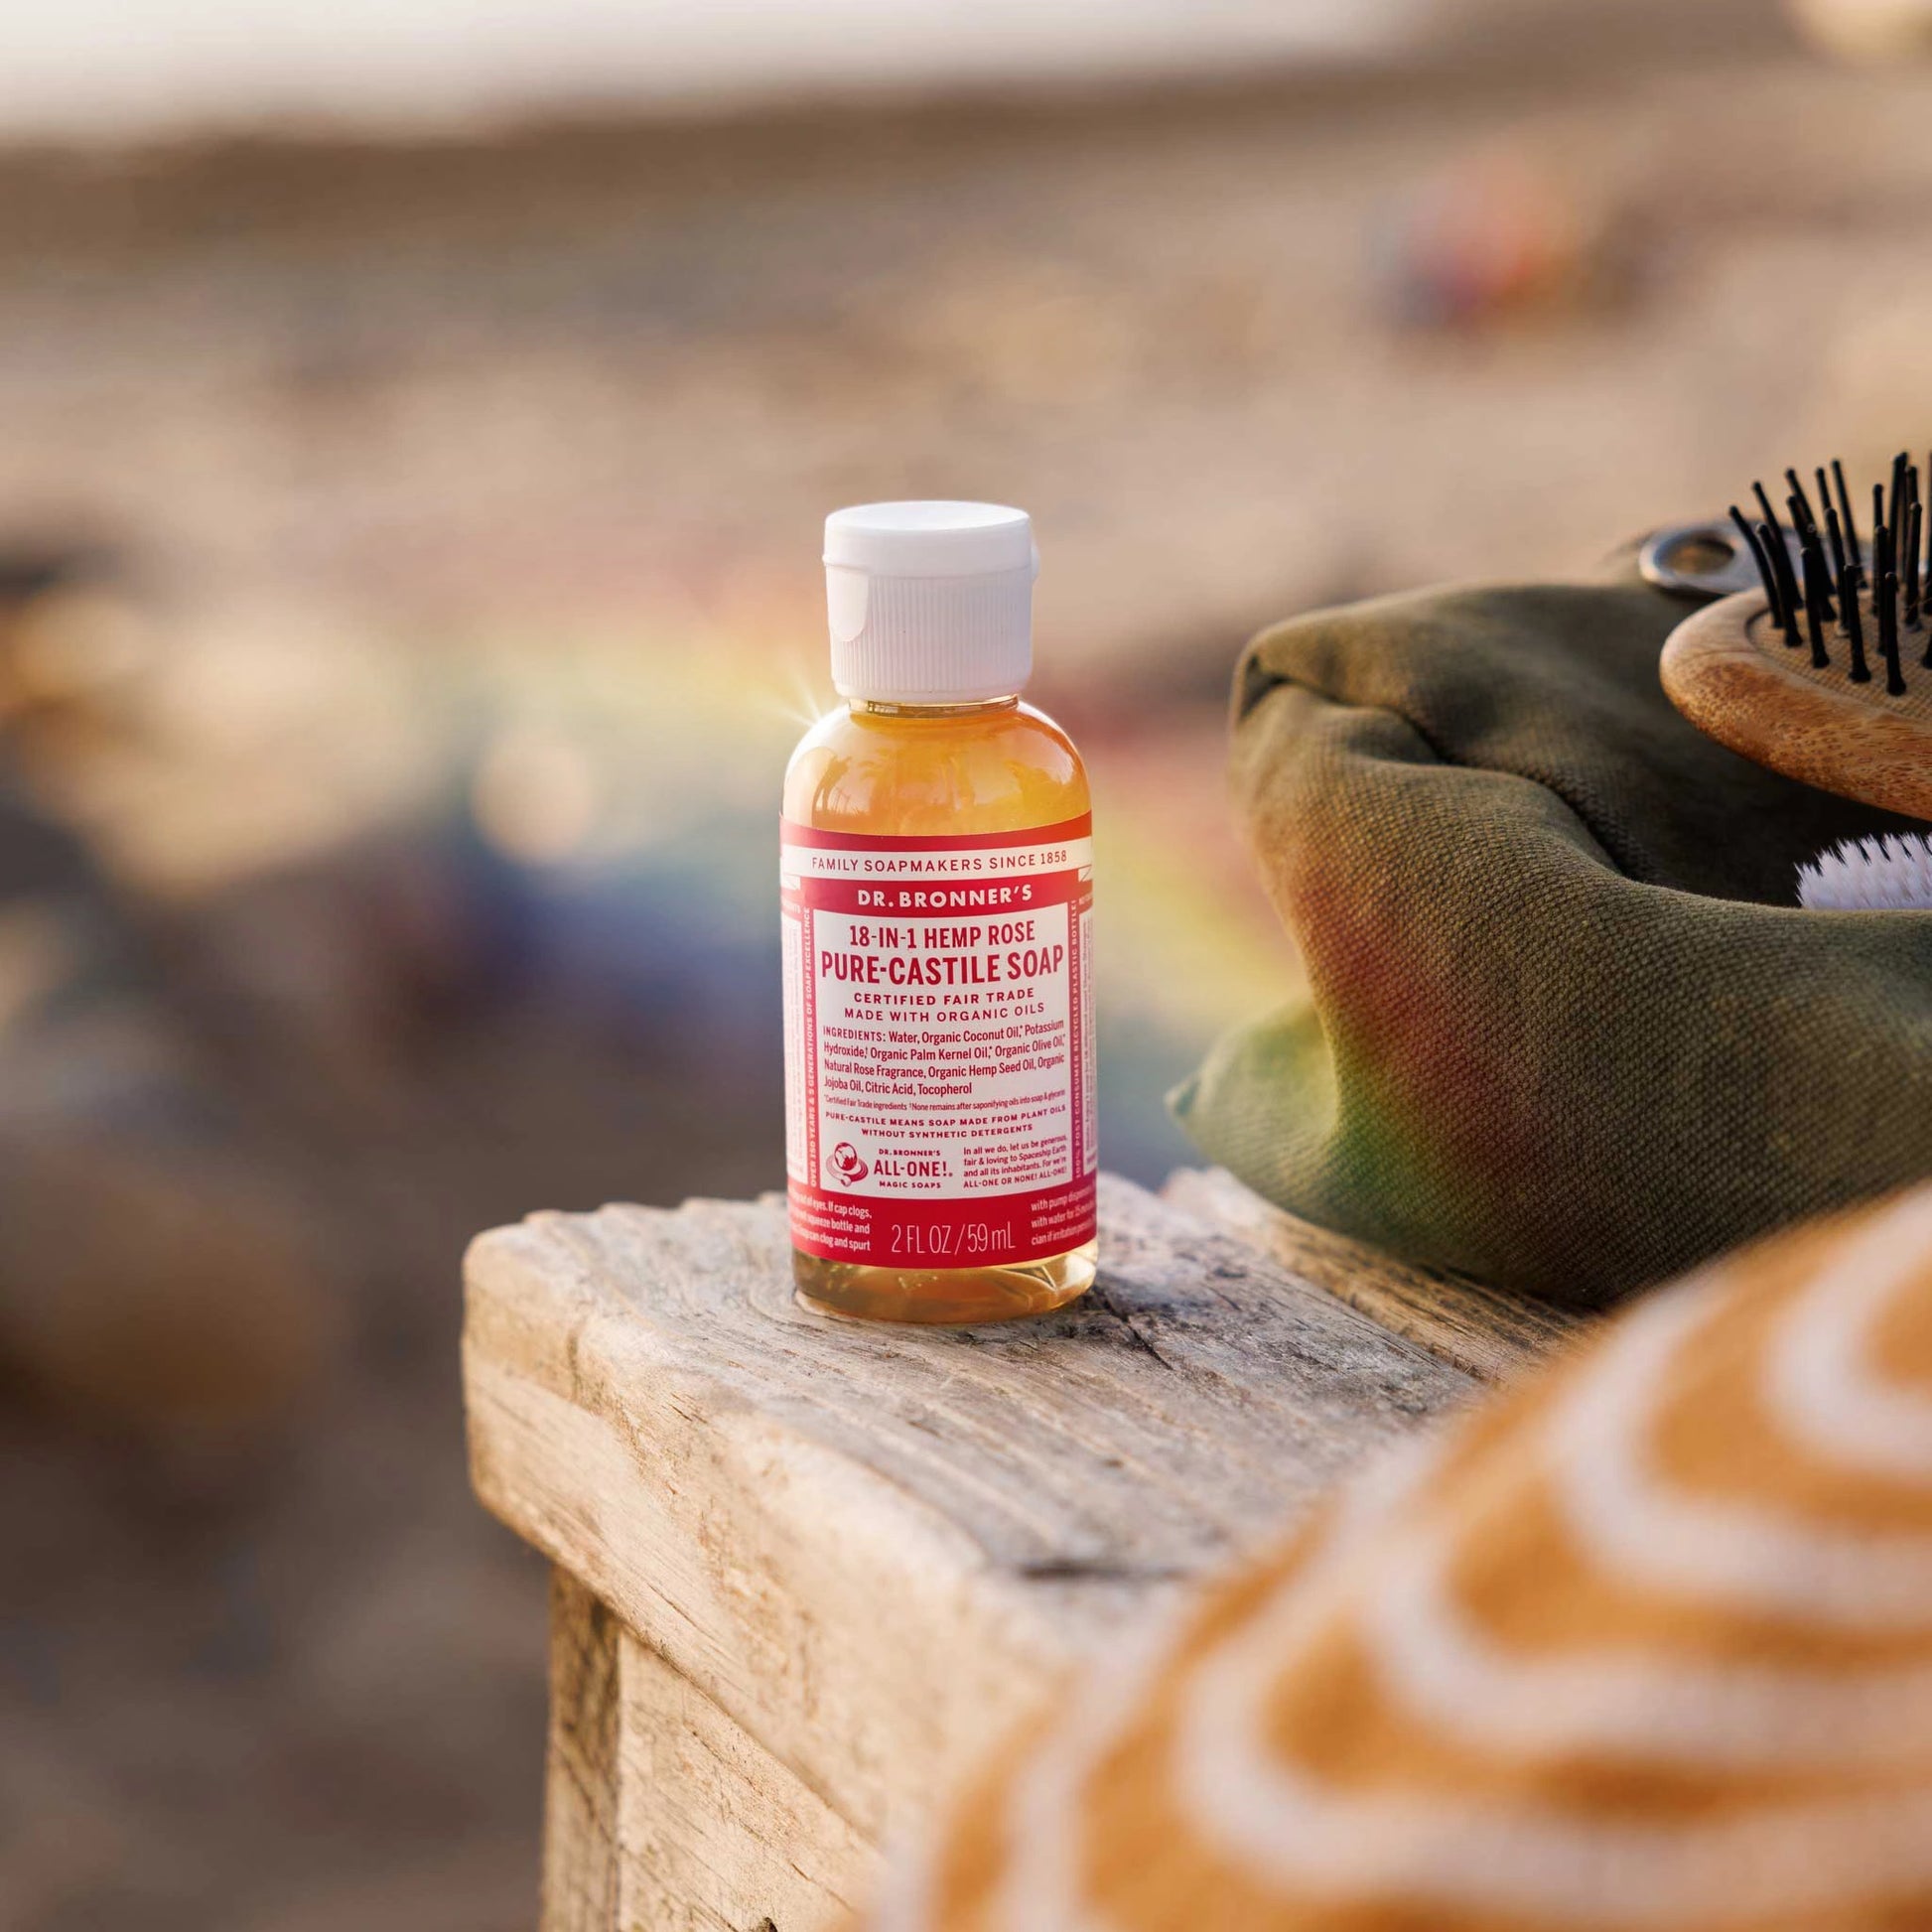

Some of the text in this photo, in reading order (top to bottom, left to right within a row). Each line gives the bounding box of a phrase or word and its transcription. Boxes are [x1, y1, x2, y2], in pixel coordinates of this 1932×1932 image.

[812, 850, 1067, 872] FAMILY SOAPMAKERS SINCE 1858
[858, 884, 1033, 907] DR. BRONNER'S
[803, 906, 812, 971] EXCELLENCE
[850, 920, 1035, 949] 18-IN-1 HEMP ROSE
[821, 944, 1063, 986] PURE-CASTILE SOAP
[854, 988, 1035, 1006] CERTIFIED FAIR TRADE
[805, 1002, 813, 1016] OF
[844, 1002, 1044, 1022] MADE WITH ORGANIC OILS
[823, 1026, 886, 1042] INGREDIENTS:
[889, 1031, 920, 1044] Water,
[921, 1032, 961, 1045] Organic
[963, 1029, 1005, 1042] Coconut
[1025, 1019, 1064, 1036] Potassium
[1071, 996, 1080, 1052] RECYCLED
[805, 1016, 815, 1088] GENERATIONS
[870, 1047, 908, 1061] Organic
[910, 1048, 936, 1060] Palm
[938, 1047, 972, 1060] Kernel
[995, 1042, 1031, 1058] Organic
[1033, 1039, 1052, 1052] Olive
[824, 1052, 1065, 1080] Natural Rose Fragrance, Organic Hemp Seed Oil, Organic
[823, 1075, 973, 1098] Jojoba Oil, Citric Acid, Tocopherol
[807, 1097, 815, 1106] &
[858, 1099, 873, 1109] Trade
[874, 1101, 907, 1111] ingredients
[957, 1102, 972, 1111] after
[973, 1099, 1009, 1110] saponifying
[1009, 1097, 1020, 1106] oils
[1020, 1095, 1032, 1104] into
[1032, 1094, 1044, 1103] soap
[825, 1104, 1066, 1127] PURE-CASTILE MEANS SOAP MADE FROM PLANT OILS
[862, 1123, 1034, 1139] WITHOUT SYNTHETIC DETERGENTS
[963, 1147, 972, 1156] In
[973, 1146, 983, 1155] all
[1009, 1143, 1020, 1152] let
[963, 1158, 977, 1167] fair
[978, 1157, 985, 1166] &
[986, 1155, 1009, 1166] loving
[1019, 1149, 1051, 1161] Spaceship
[1051, 1144, 1066, 1155] Earth
[1041, 1159, 1052, 1168] For
[963, 1178, 999, 1188] ALL-ONE
[1001, 1176, 1013, 1185] OR
[1014, 1173, 1037, 1183] NONE!
[834, 1204, 848, 1216] cap
[1031, 1198, 1047, 1211] with
[1048, 1195, 1068, 1210] pump
[831, 1218, 854, 1231] bottle
[854, 1223, 870, 1234] and
[1031, 1215, 1047, 1228] with
[1048, 1212, 1066, 1224] water
[834, 1237, 848, 1248] and
[849, 1240, 871, 1252] spurt
[892, 1220, 1017, 1255] 2 FL OZ / 59 mL
